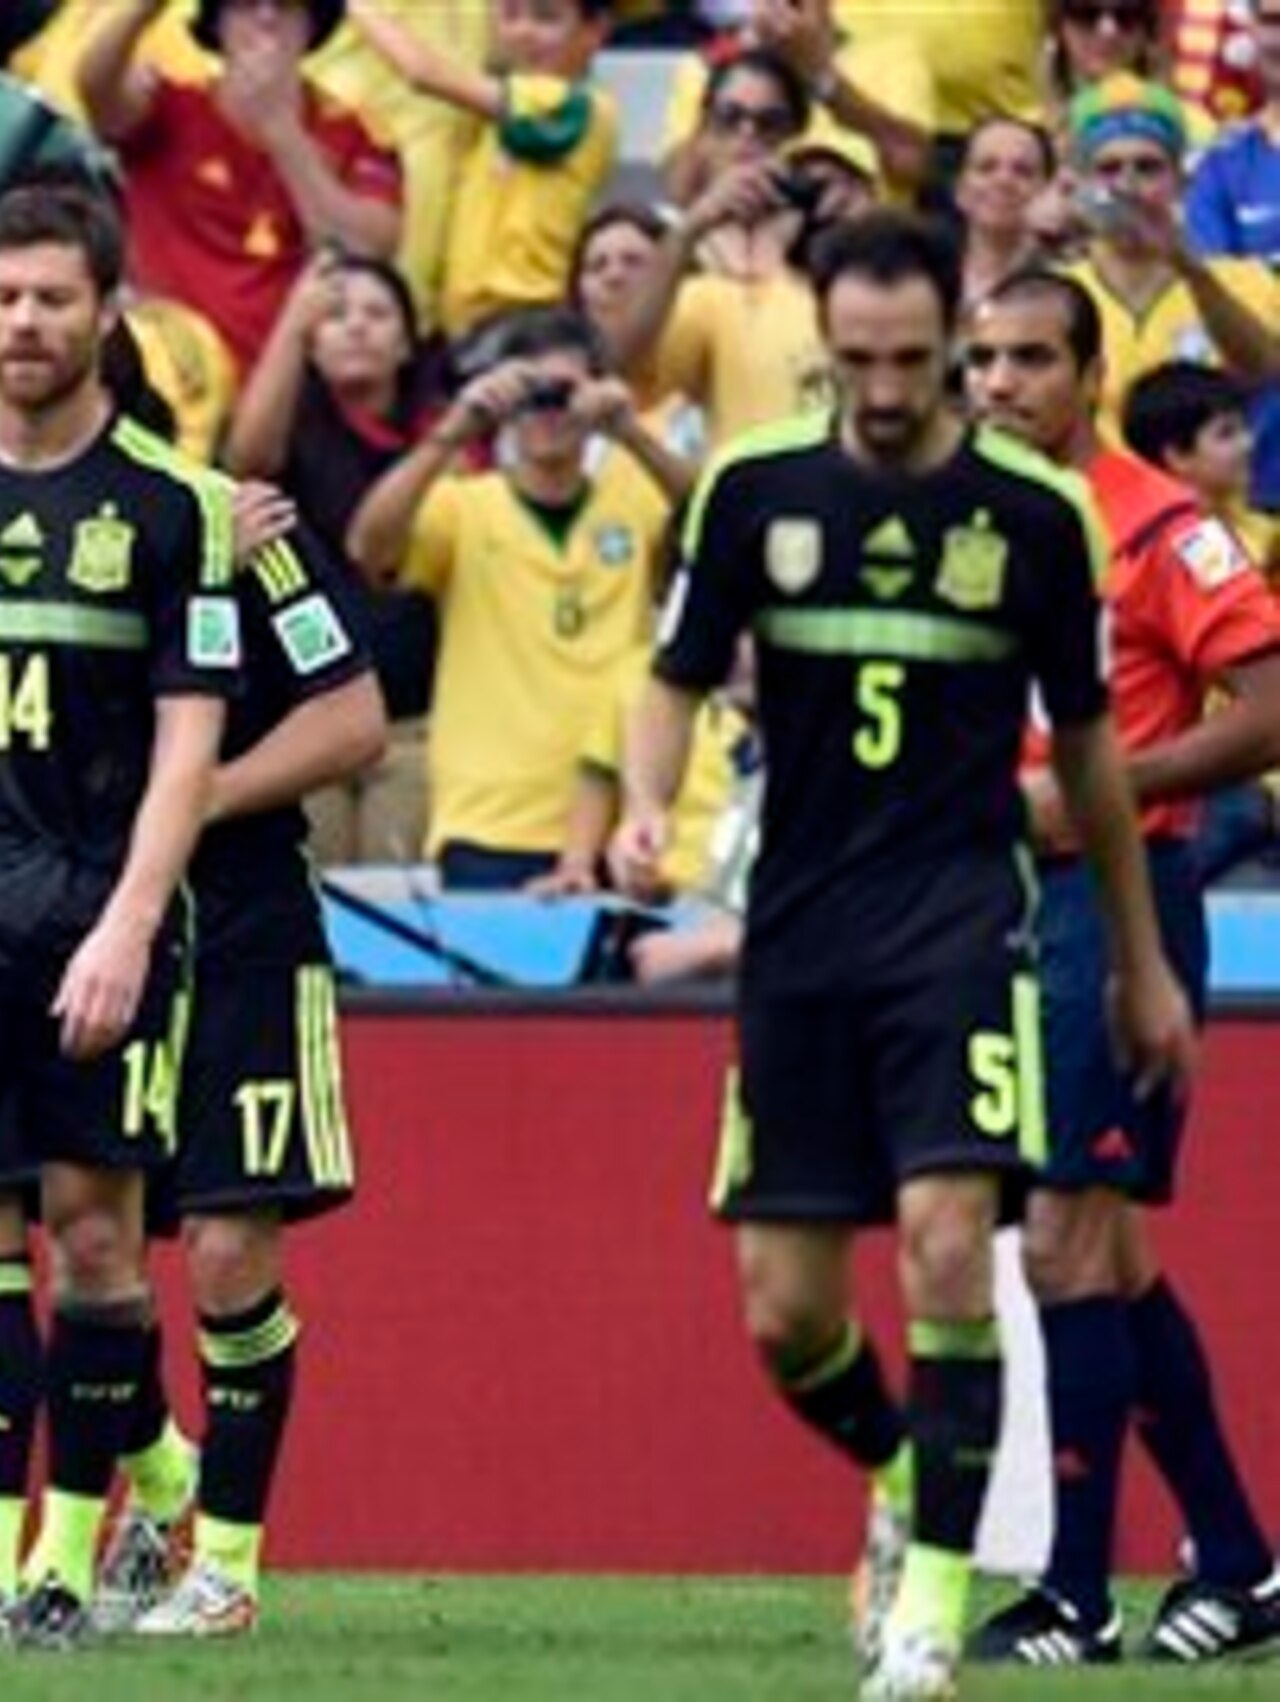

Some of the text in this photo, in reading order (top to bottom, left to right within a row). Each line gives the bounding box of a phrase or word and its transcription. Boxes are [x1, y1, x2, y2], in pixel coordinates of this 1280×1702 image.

[852, 662, 905, 769] 5
[232, 1078, 294, 1176] 17
[968, 1031, 1016, 1135] 5
